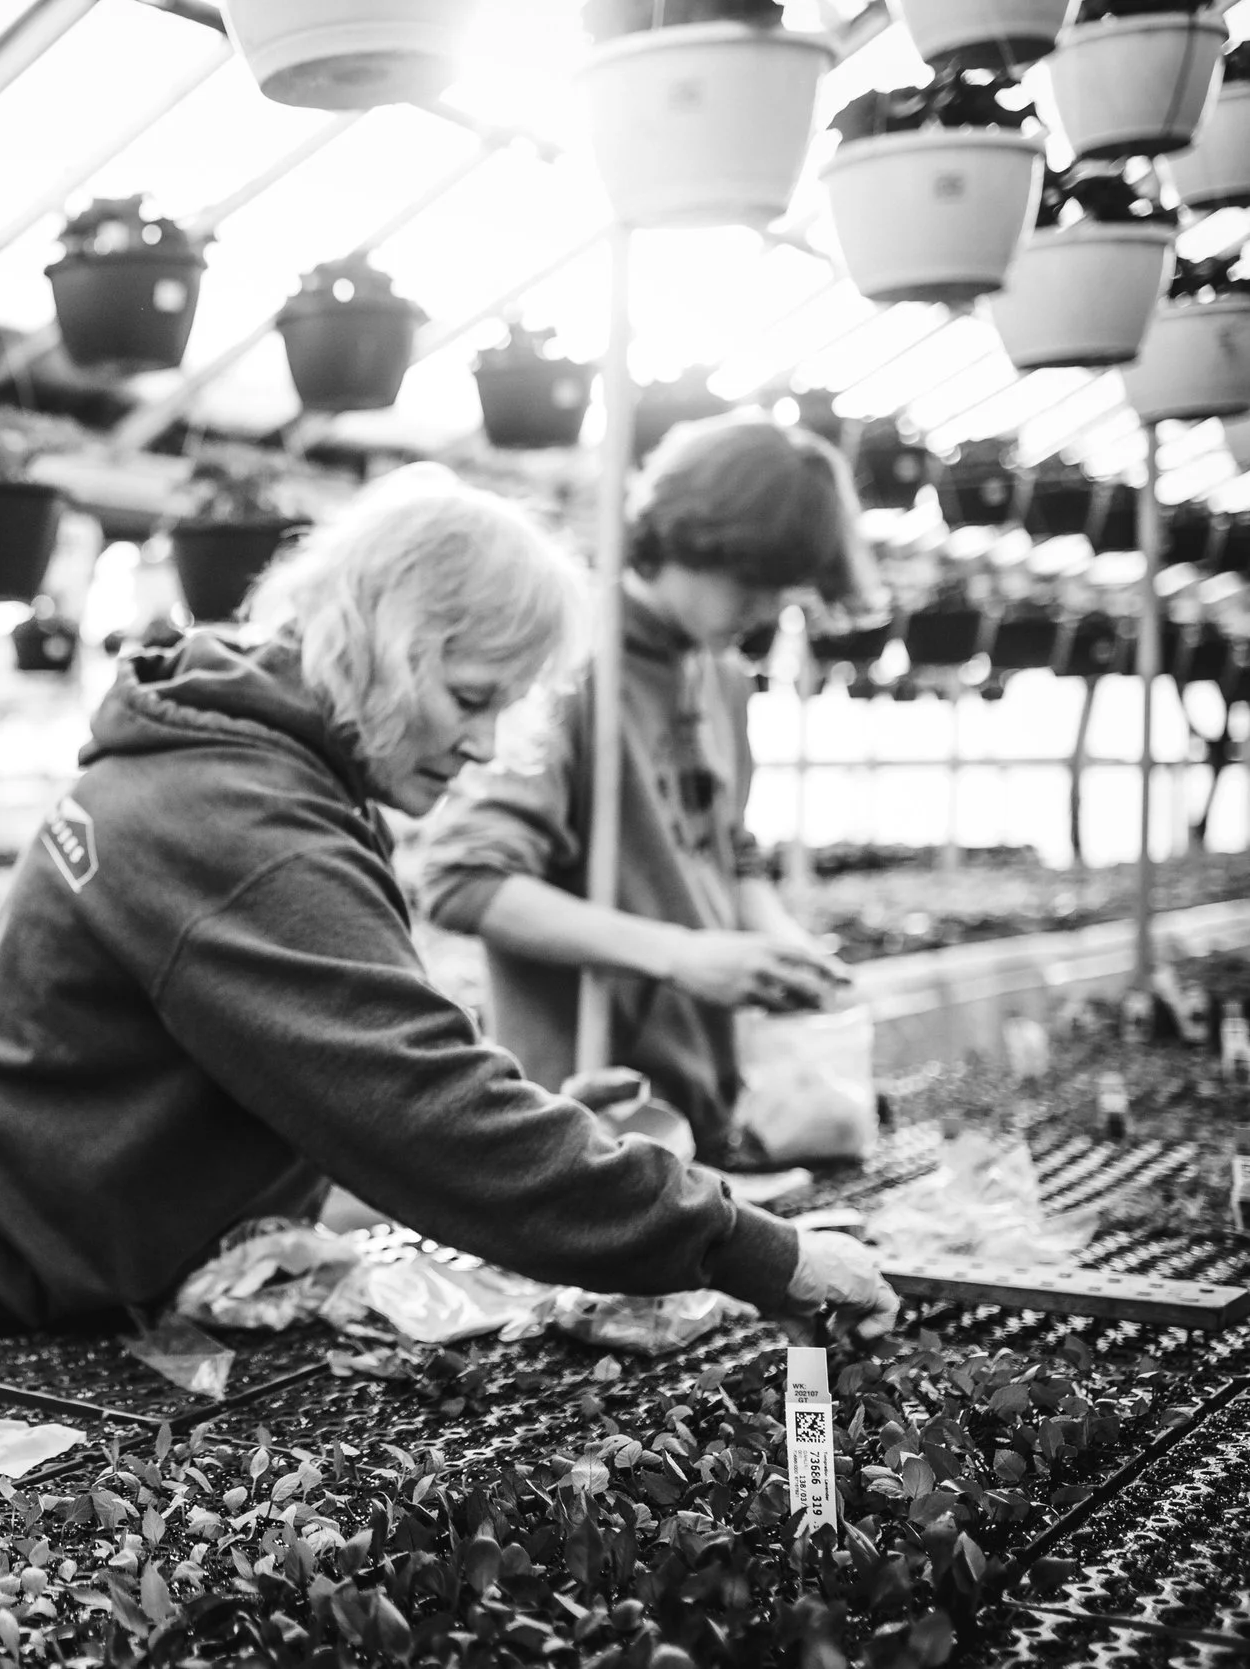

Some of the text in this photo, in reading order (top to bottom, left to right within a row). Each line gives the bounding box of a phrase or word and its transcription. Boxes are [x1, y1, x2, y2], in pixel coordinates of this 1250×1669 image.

[810, 1451, 821, 1485] 73686
[799, 1475, 808, 1507] 138/03/
[812, 1495, 823, 1516] 319
